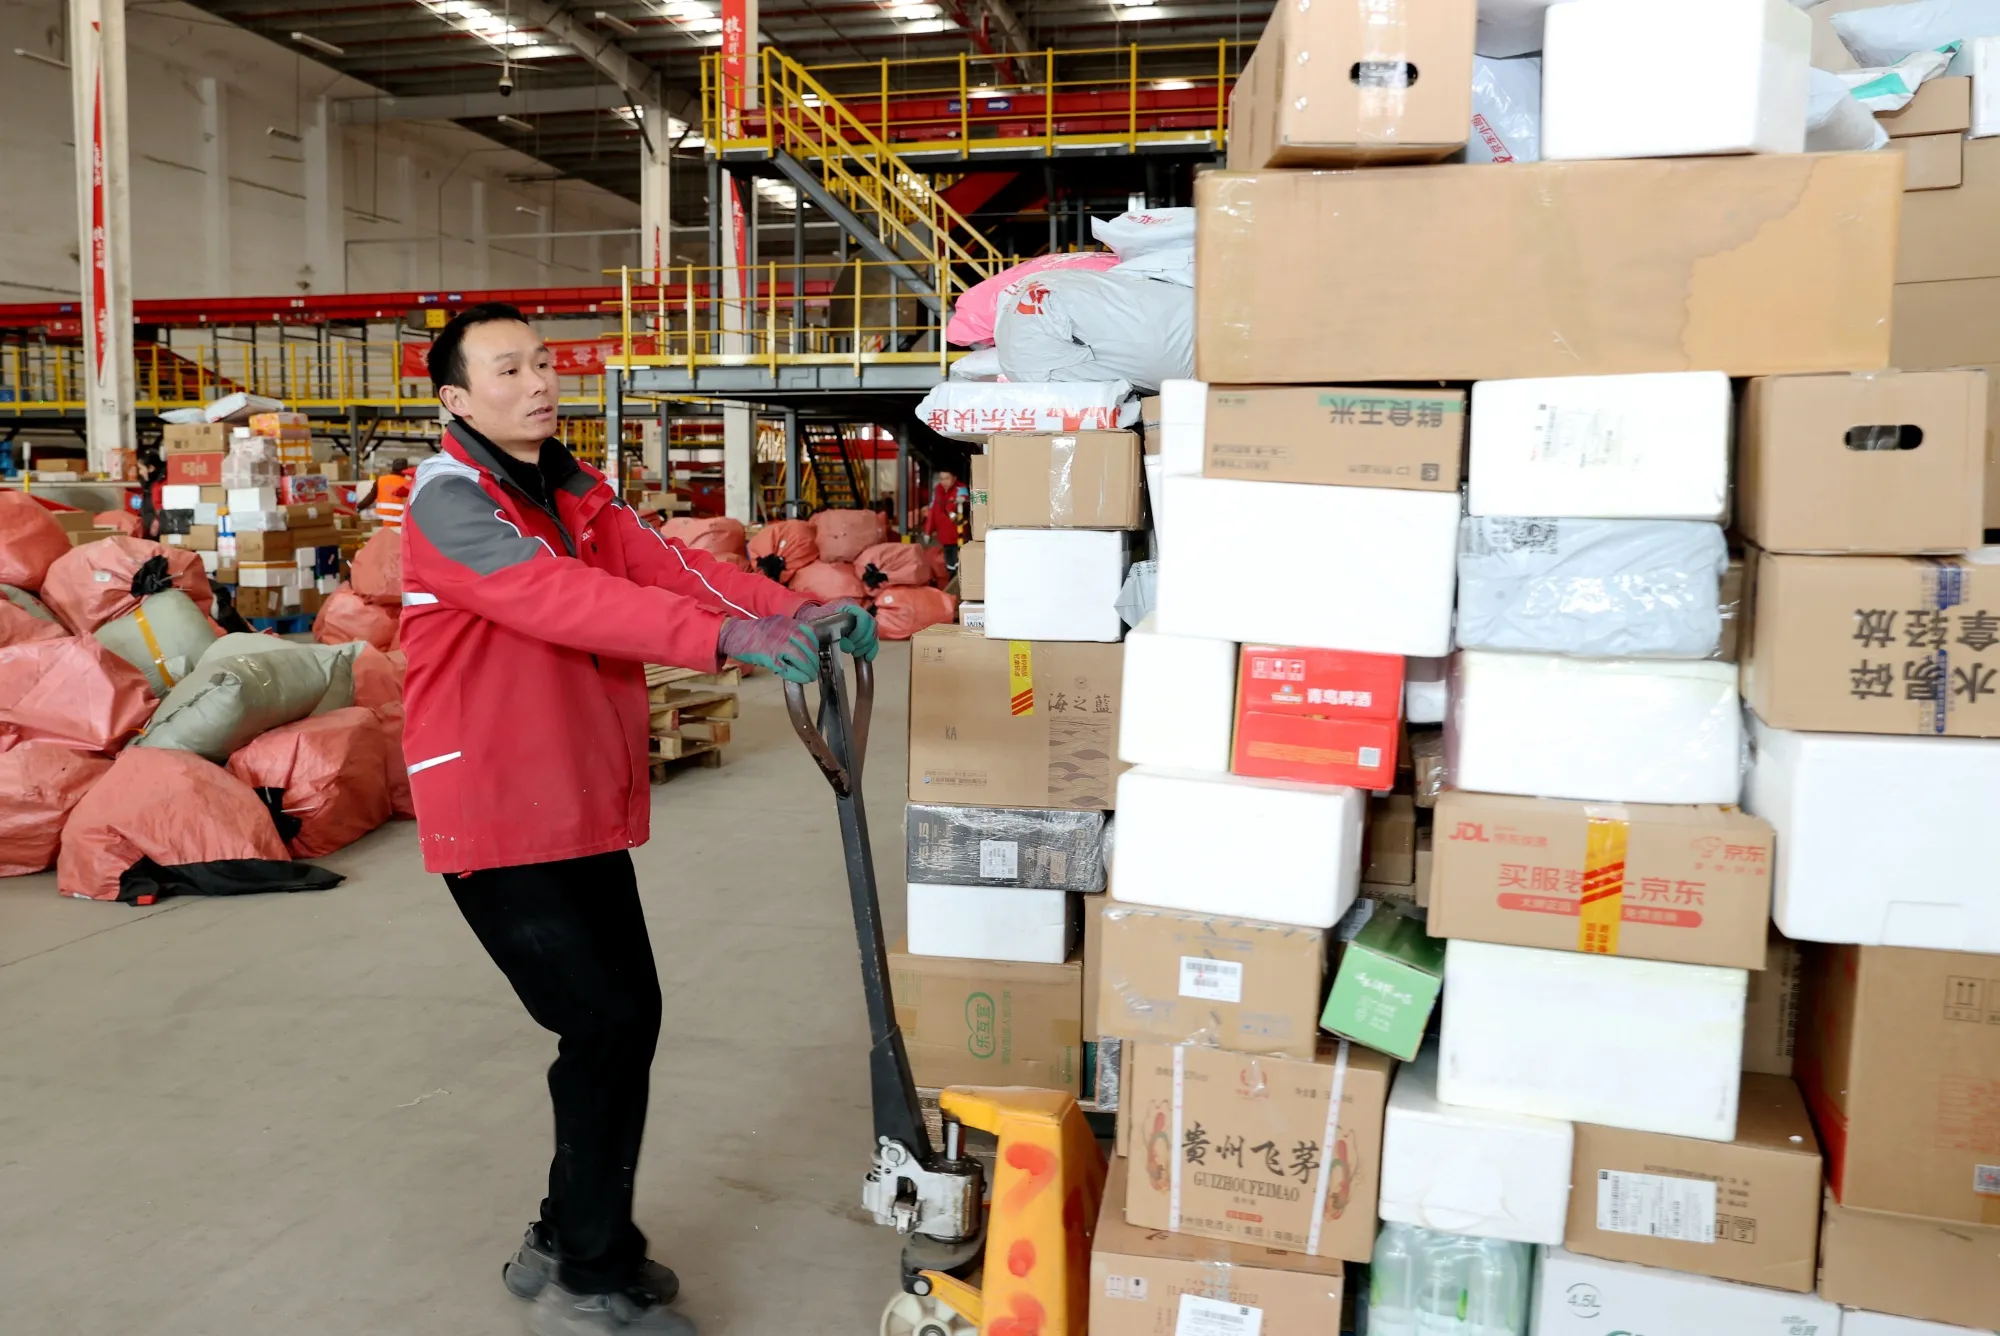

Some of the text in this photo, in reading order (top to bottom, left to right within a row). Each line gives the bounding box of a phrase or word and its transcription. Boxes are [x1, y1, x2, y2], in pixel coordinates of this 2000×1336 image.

[926, 408, 1037, 433] 京东快递
[1330, 398, 1445, 428] 鲜食玉米
[945, 726, 957, 740] KA
[1448, 822, 1490, 843] JDL
[1724, 844, 1766, 862] 京东
[1193, 1171, 1300, 1202] GUIZHOUFEIMAO
[1567, 1293, 1602, 1308] 4.5L
